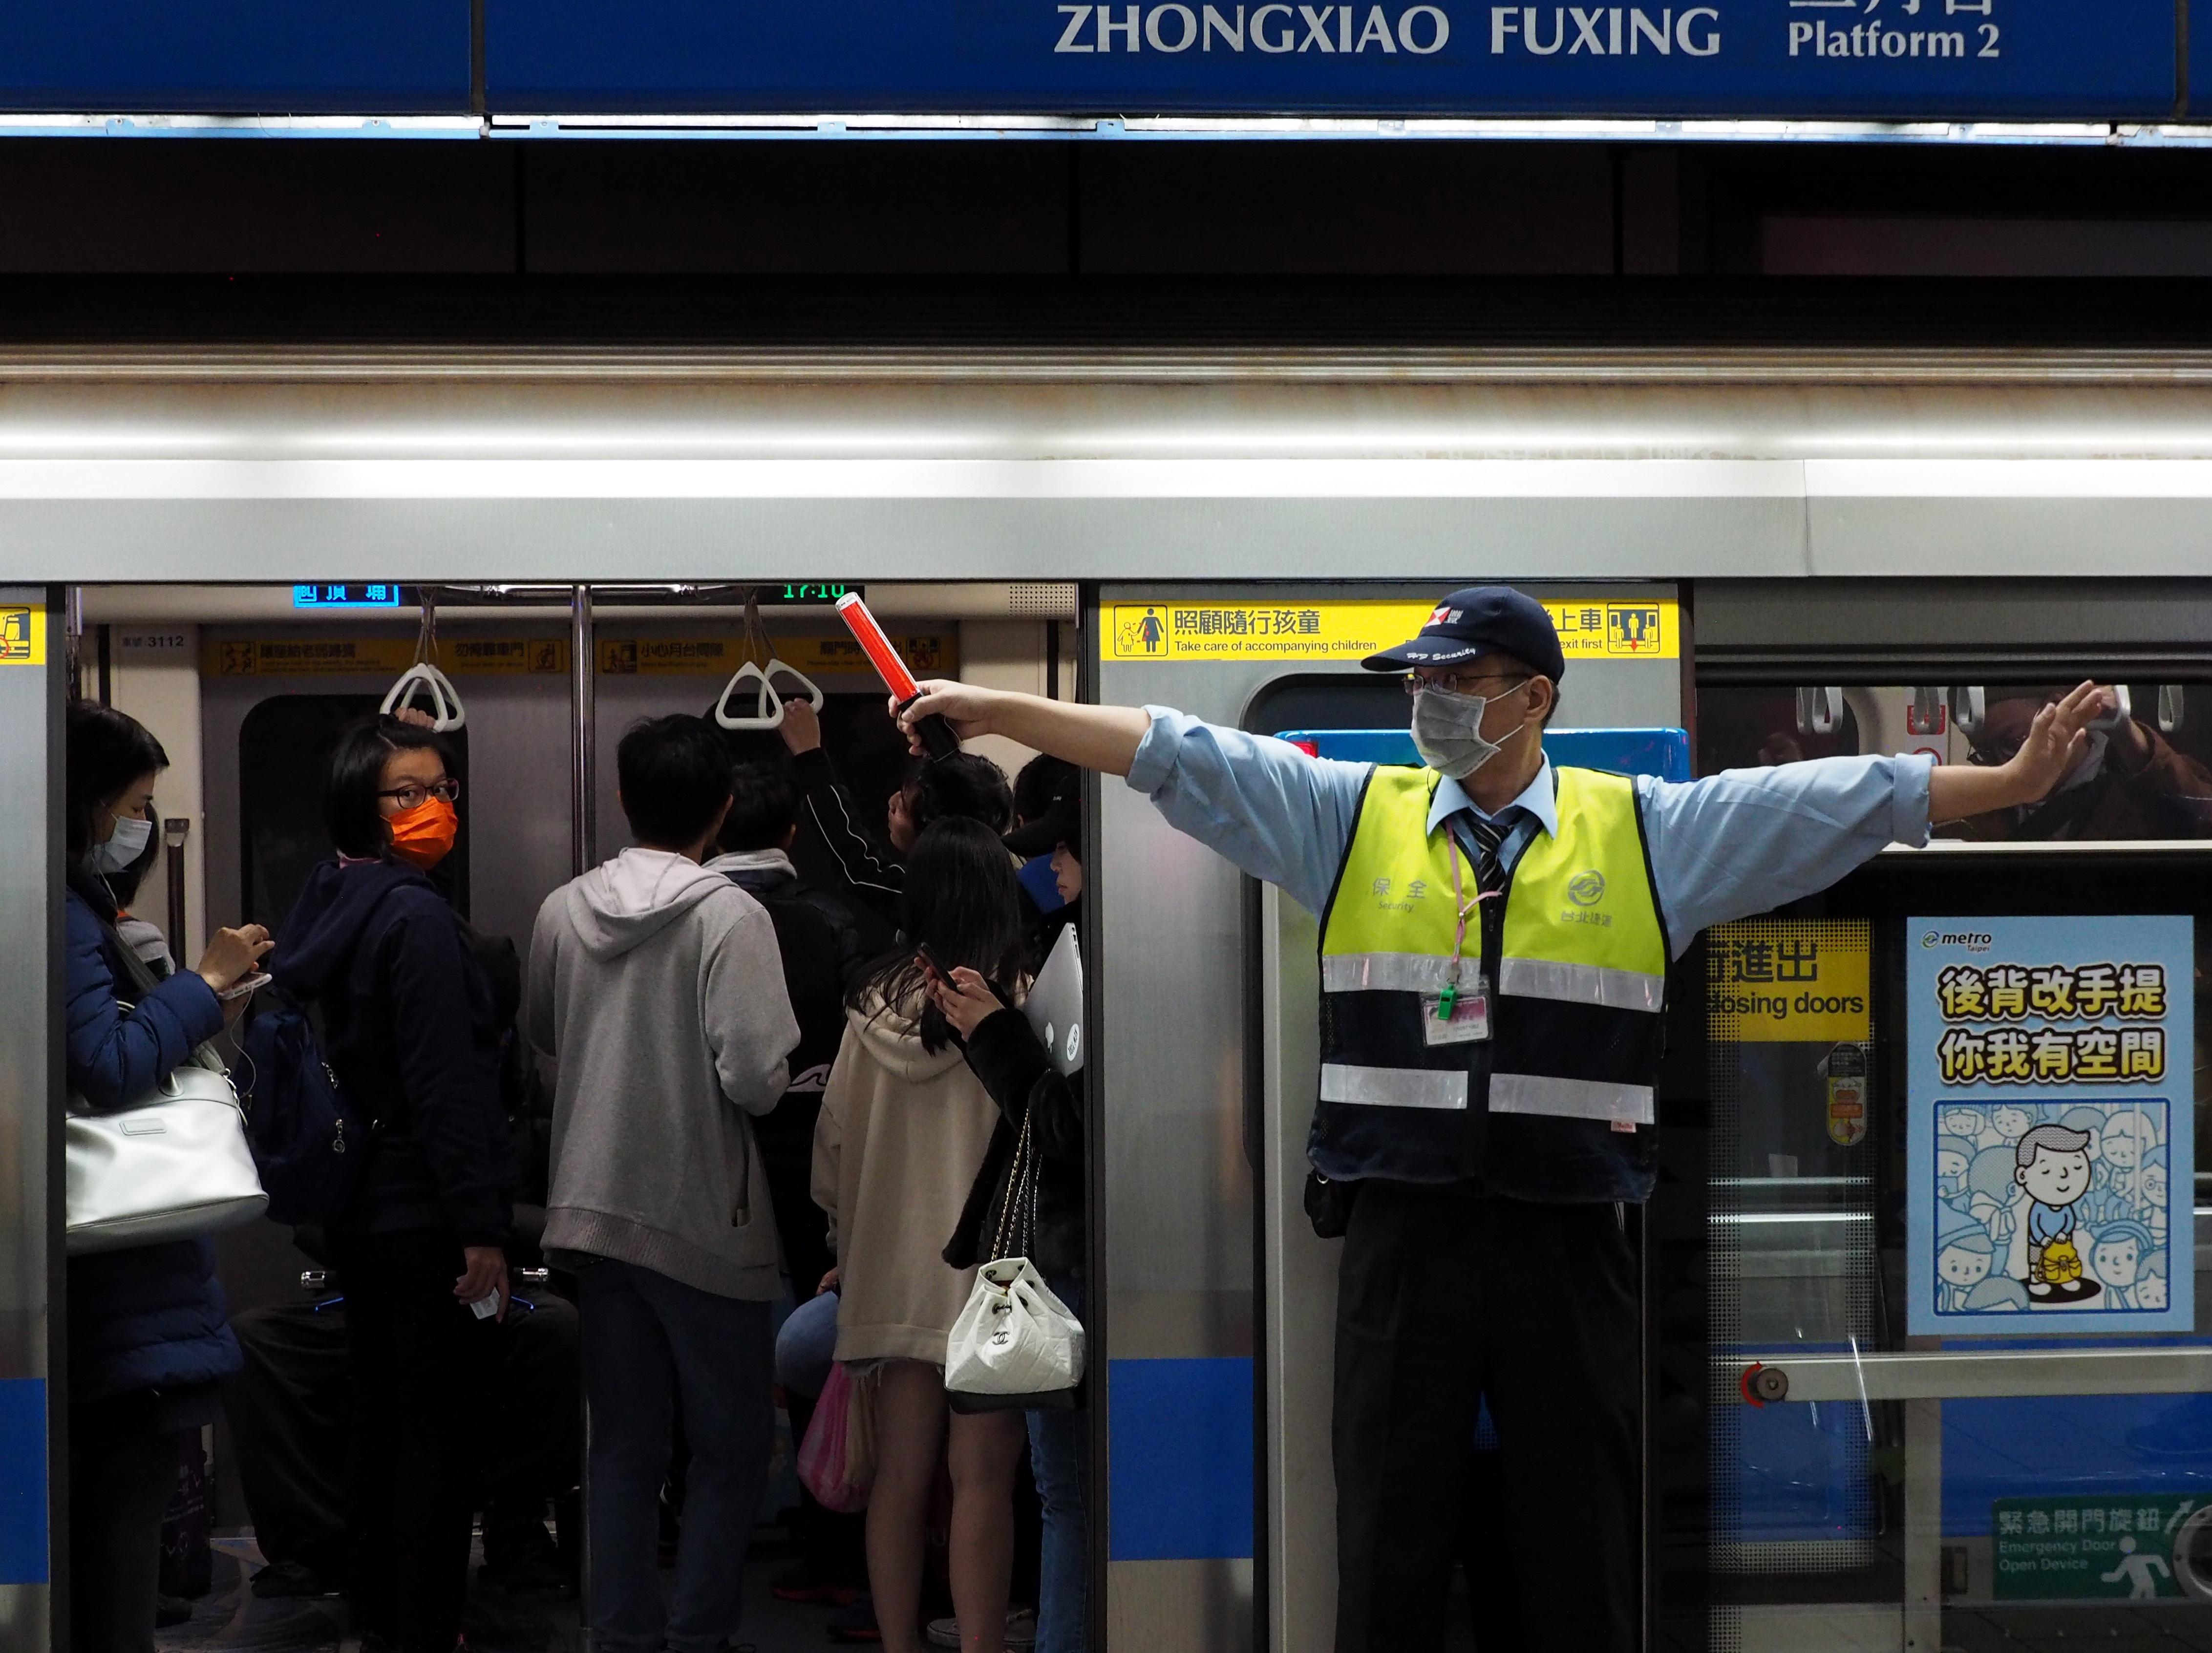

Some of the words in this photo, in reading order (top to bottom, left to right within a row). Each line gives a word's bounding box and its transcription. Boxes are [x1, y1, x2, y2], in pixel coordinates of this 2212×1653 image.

[1054, 4, 1449, 54] ZHONGXIAO
[1490, 7, 1721, 56] FUXING
[1788, 19, 1965, 57] Platform
[1977, 23, 2000, 57] 2
[784, 585, 845, 598] 17:10
[1174, 610, 1321, 636] 照顧隨行孩童
[1547, 608, 1602, 632] 上車
[148, 636, 184, 648] 3112
[1174, 641, 1201, 651] Take
[1231, 641, 1243, 651] of
[1245, 640, 1329, 653] accompanying
[1331, 640, 1377, 651] children
[1560, 639, 1578, 649] exit
[1581, 638, 1603, 649] first
[1432, 648, 1476, 660] Security
[1373, 877, 1427, 899] 保全
[1378, 901, 1414, 913] Security
[1941, 932, 1992, 944] metro
[1967, 945, 1990, 953] Taipei
[1939, 964, 2165, 1018] 後背改手提
[1794, 992, 1864, 1013] doors
[1939, 1028, 2164, 1080] 你我有空間
[1999, 1508, 2160, 1534] 緊急開門旋鈕
[1999, 1541, 2078, 1555] Emergency
[2081, 1539, 2117, 1552] Door
[1999, 1559, 2037, 1573] Open
[2040, 1558, 2088, 1570] Device
